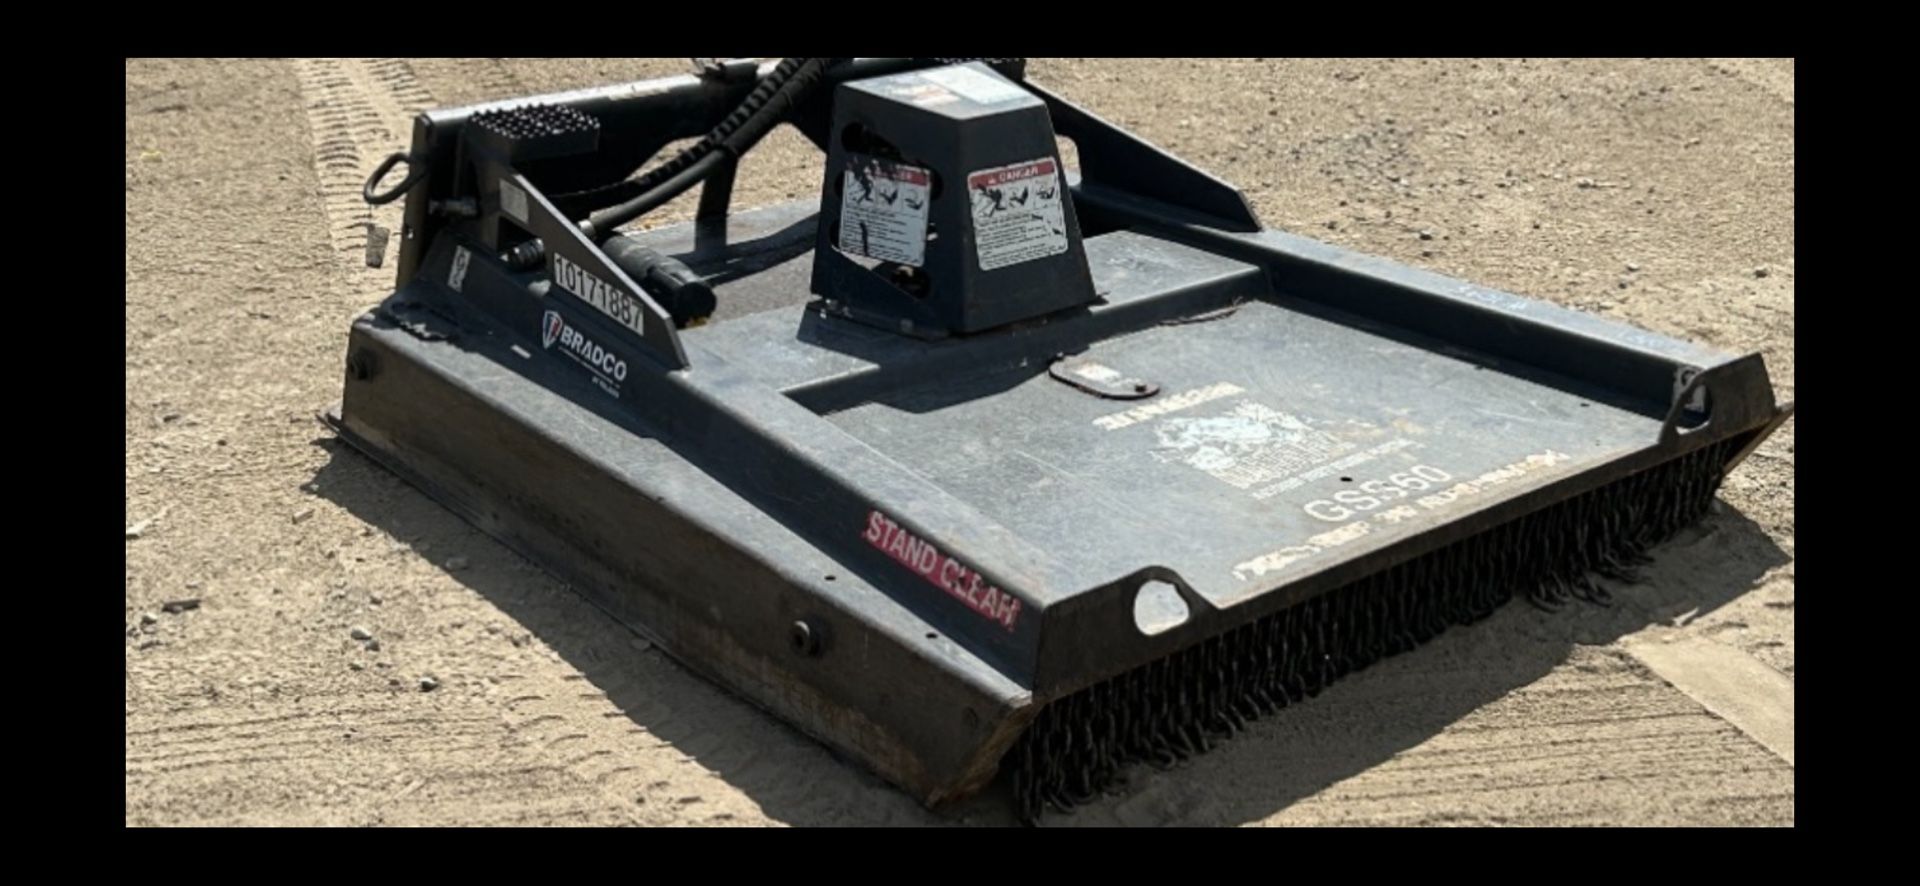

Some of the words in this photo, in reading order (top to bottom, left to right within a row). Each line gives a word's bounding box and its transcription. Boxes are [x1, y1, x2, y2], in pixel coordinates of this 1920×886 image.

[555, 256, 644, 331] 10171887
[560, 324, 627, 381] BRADCO
[1303, 464, 1451, 522] GSS60
[866, 510, 938, 574] STAND
